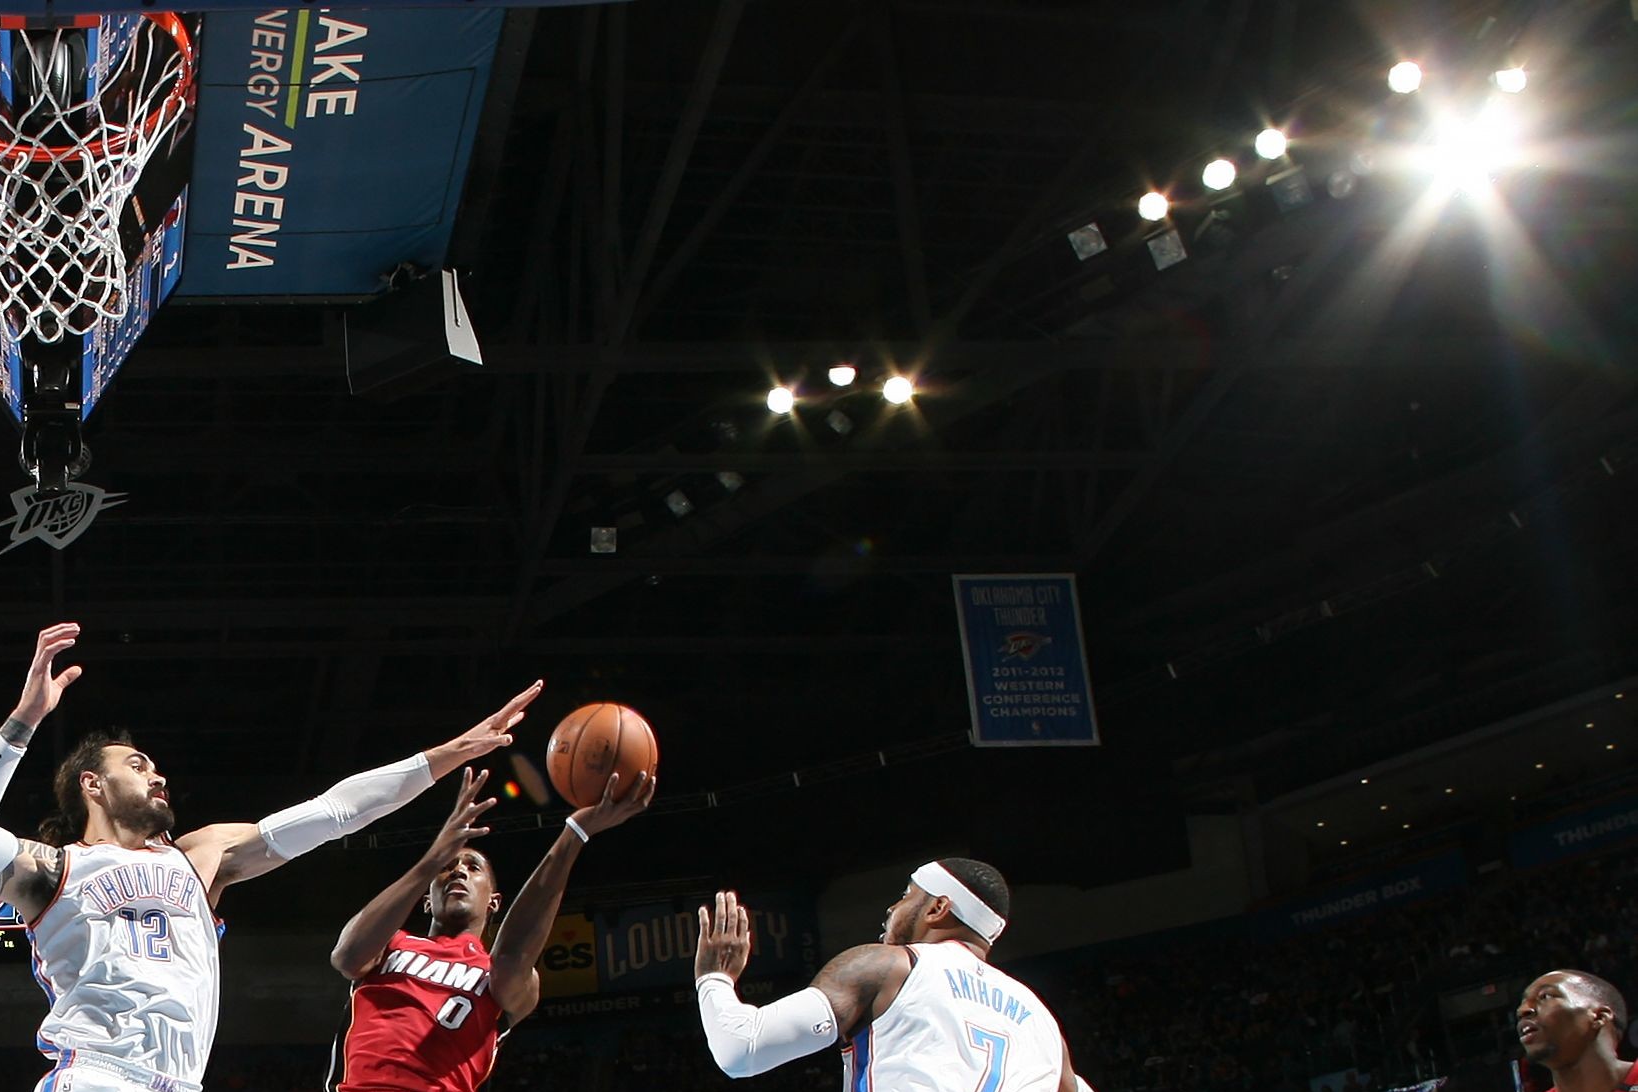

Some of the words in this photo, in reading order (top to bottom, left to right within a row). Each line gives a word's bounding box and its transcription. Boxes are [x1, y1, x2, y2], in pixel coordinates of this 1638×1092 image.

[226, 123, 293, 269] ARENA
[983, 694, 1080, 704] CONFERENCE
[994, 681, 1064, 691] WESTERN
[990, 706, 1076, 717] CHAMPIONS
[82, 863, 198, 914] THUNDER
[1291, 892, 1378, 926] THUNDER
[1382, 876, 1422, 899] BOX
[119, 907, 172, 962] 12
[606, 911, 696, 980] LOUD
[436, 995, 472, 1029] 0
[545, 996, 642, 1018] THUNDER
[944, 969, 1031, 1025] ANTHONY
